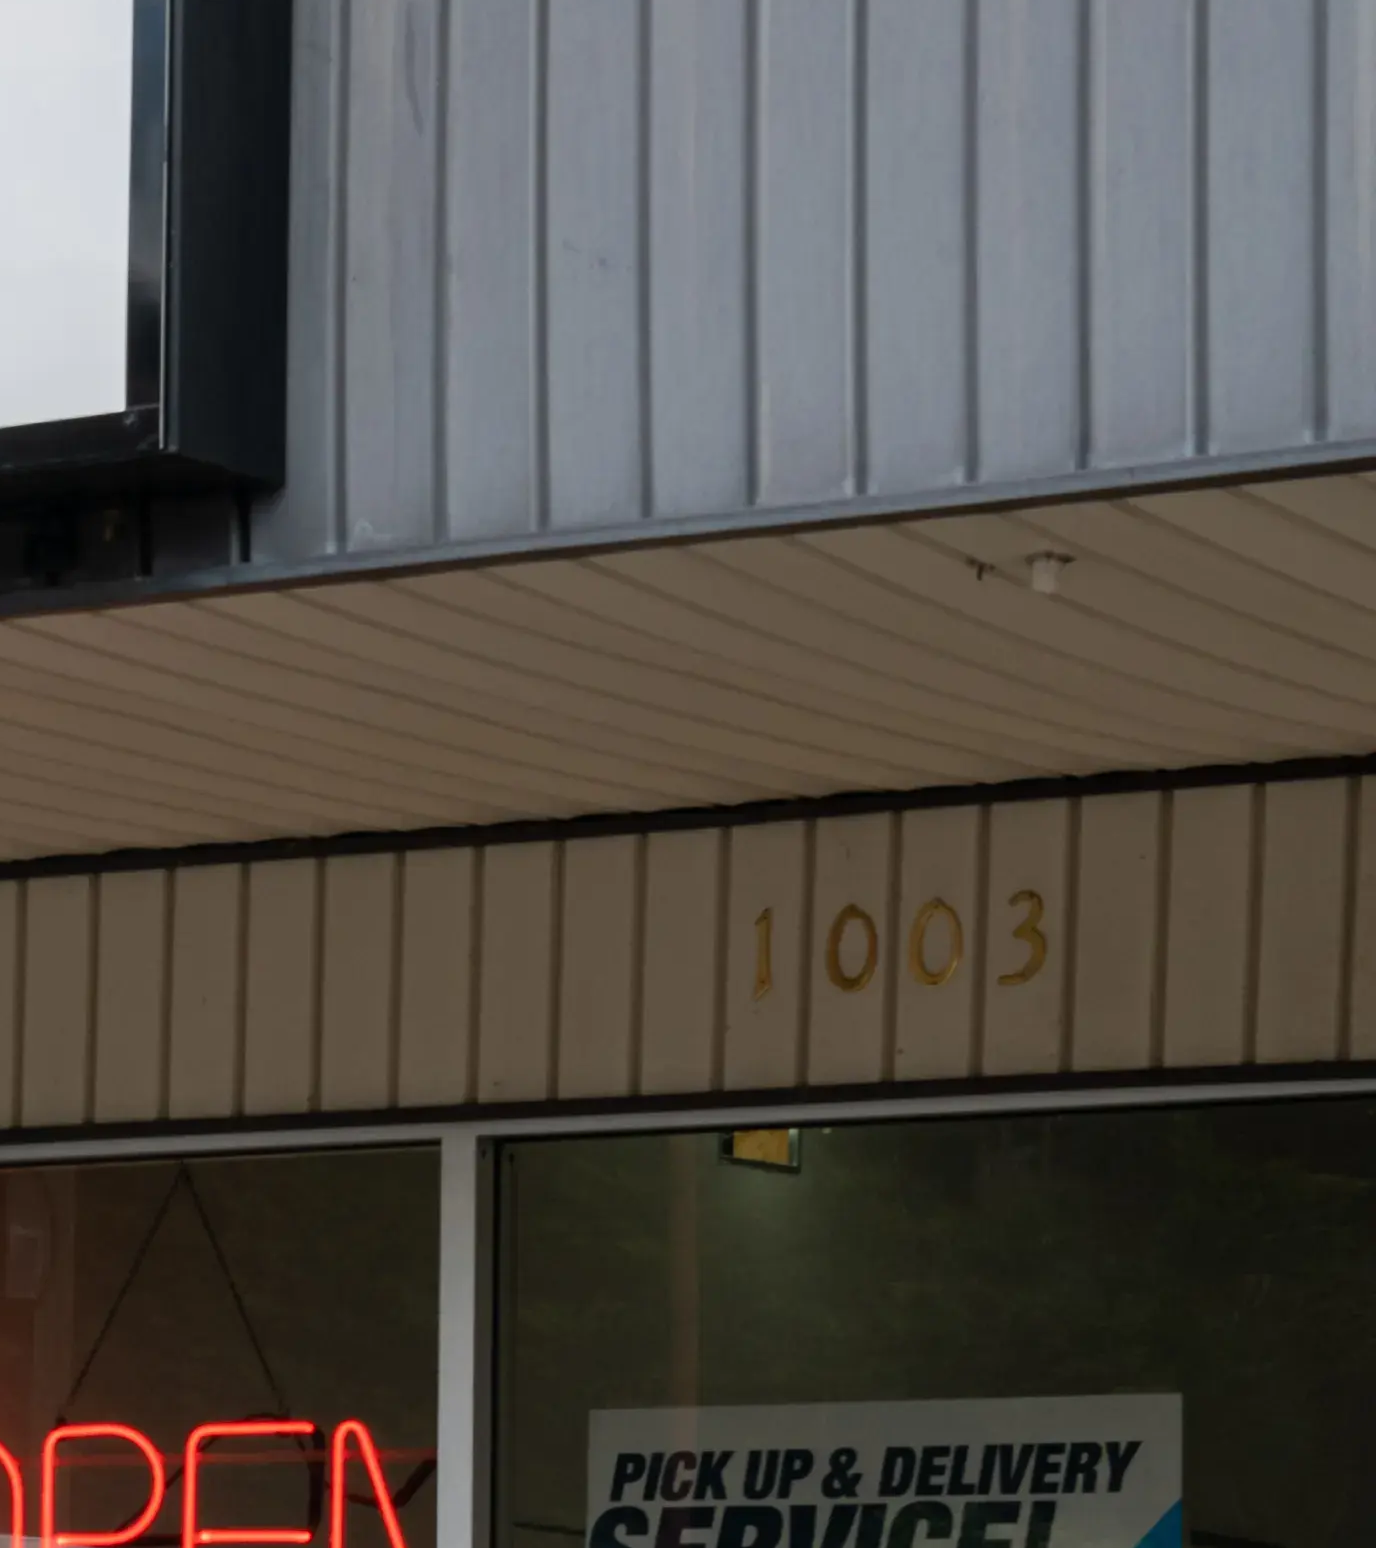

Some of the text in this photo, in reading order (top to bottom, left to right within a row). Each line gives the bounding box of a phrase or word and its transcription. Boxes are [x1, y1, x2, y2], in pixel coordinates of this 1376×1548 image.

[754, 889, 1047, 1001] 1003
[610, 1440, 1143, 1502] PICK UP & DELIVERY
